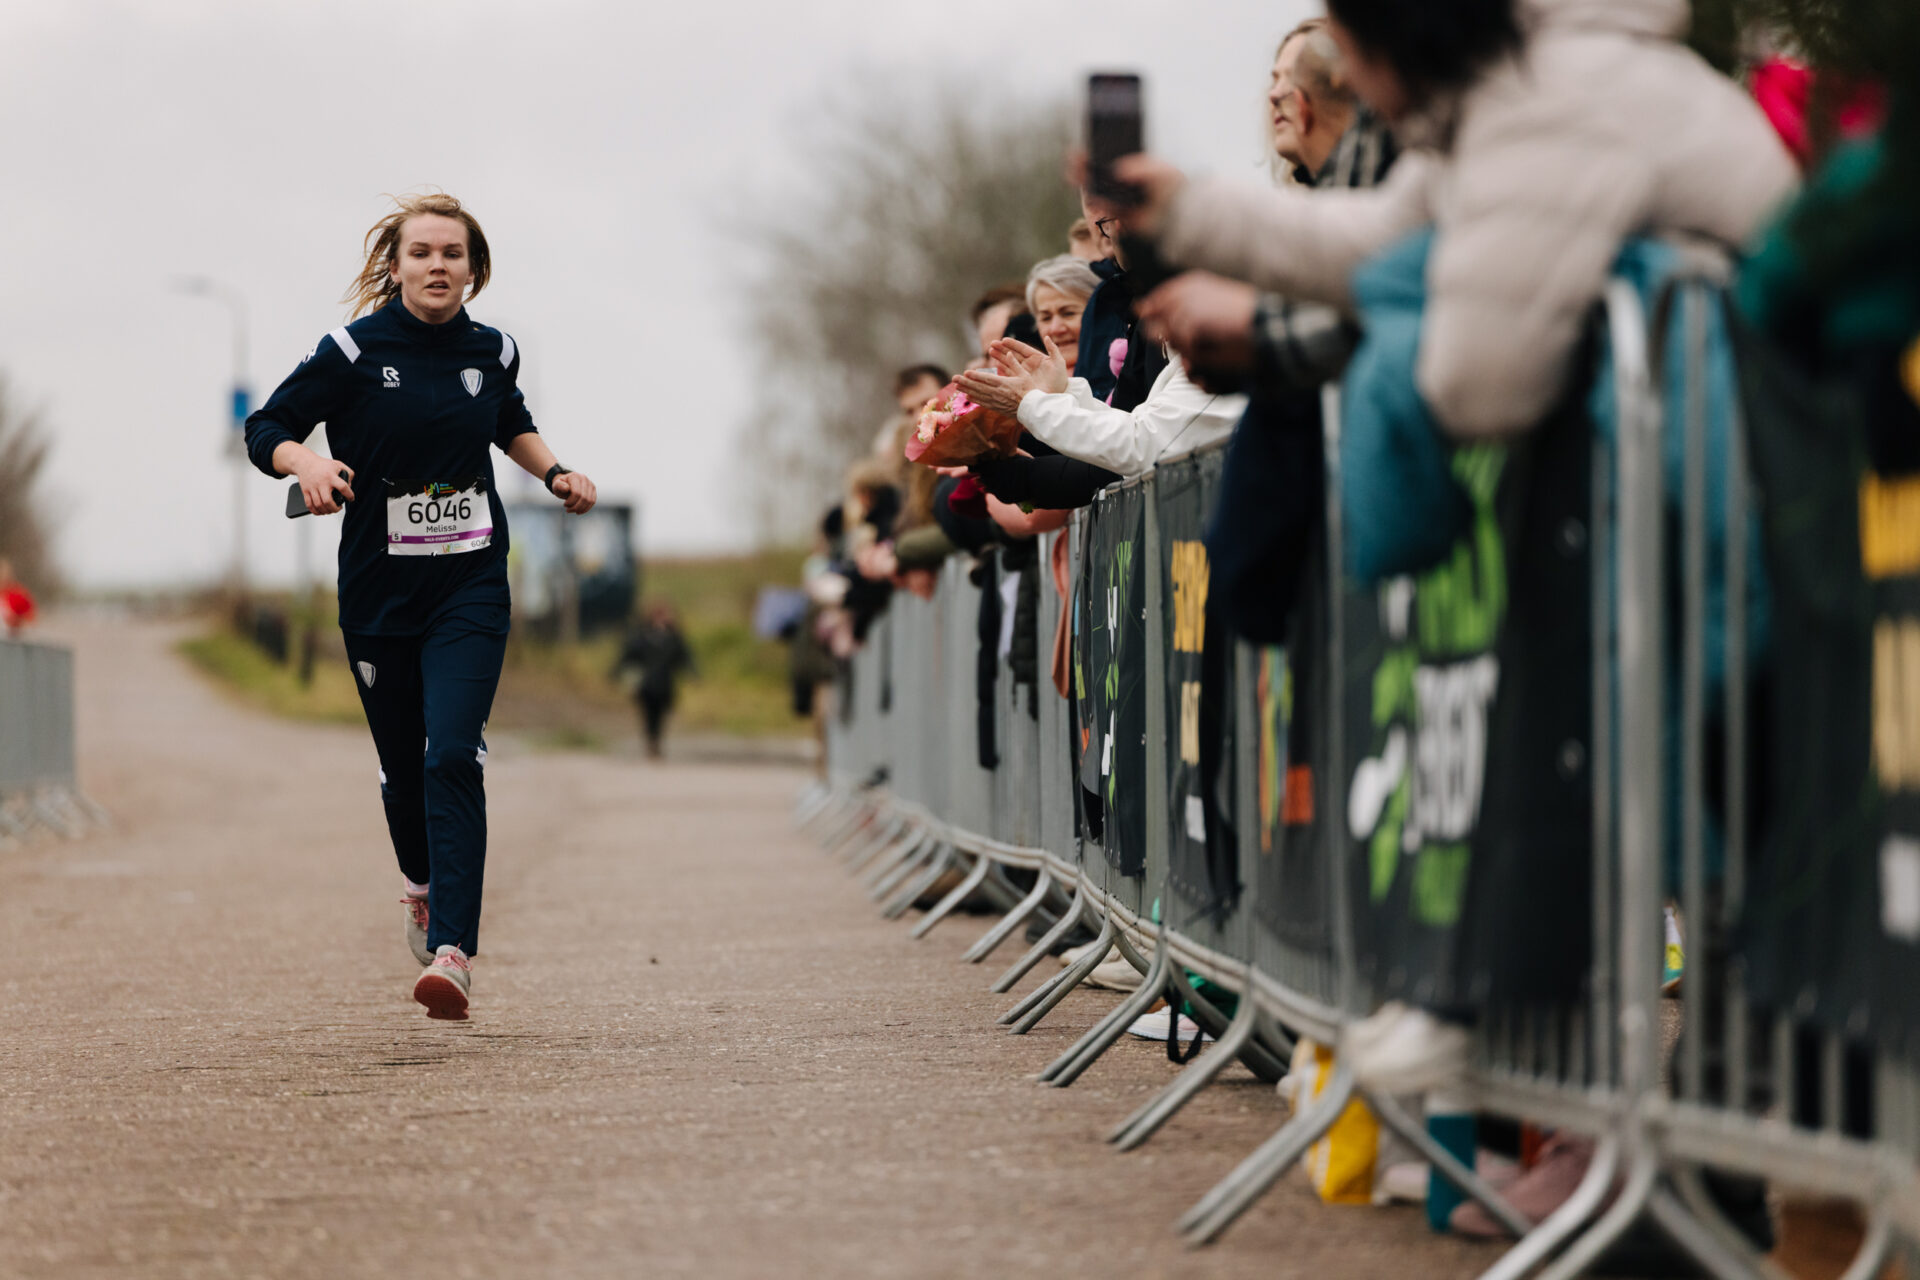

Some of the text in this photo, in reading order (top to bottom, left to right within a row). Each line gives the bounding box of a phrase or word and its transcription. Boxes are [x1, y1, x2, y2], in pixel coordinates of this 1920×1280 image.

[408, 497, 471, 524] 6046
[426, 524, 457, 533] Melissa
[394, 532, 399, 541] 5
